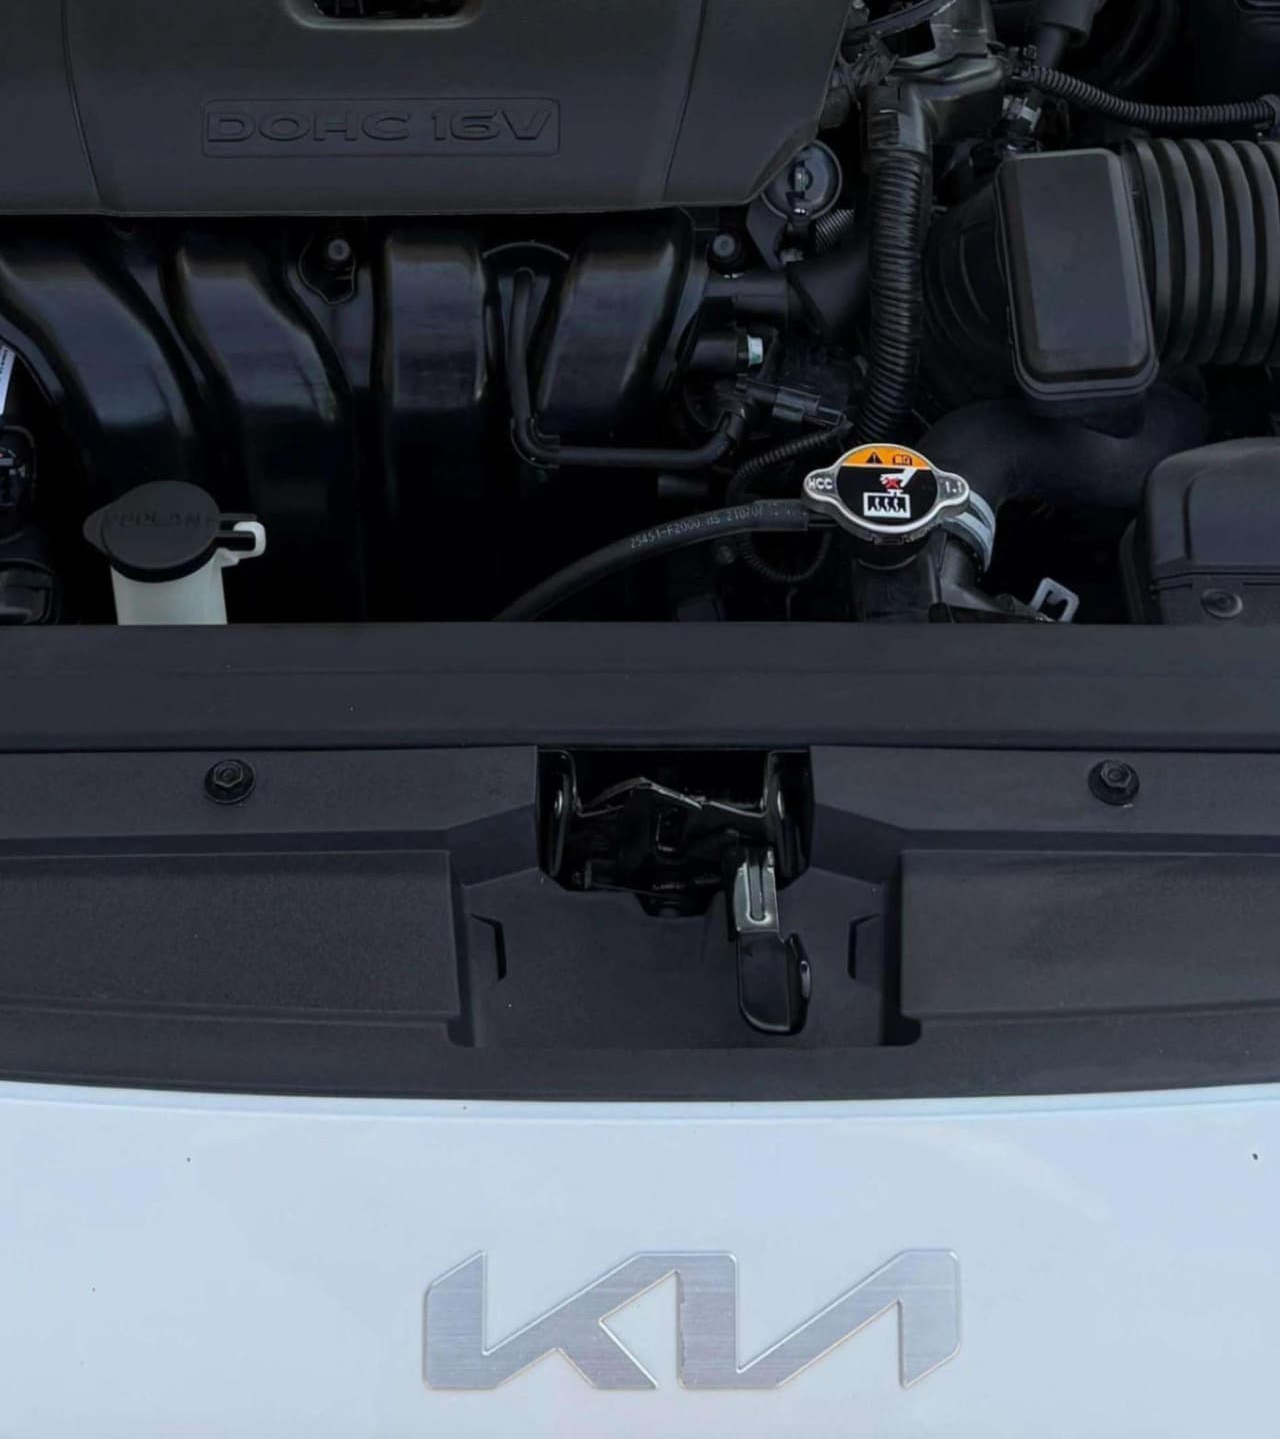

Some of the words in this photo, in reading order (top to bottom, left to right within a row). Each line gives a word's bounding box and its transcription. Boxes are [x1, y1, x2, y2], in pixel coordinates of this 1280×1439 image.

[207, 110, 411, 143] DOHC
[431, 110, 552, 142] 16V
[807, 477, 834, 490] HCC
[423, 1248, 962, 1390] KIA
